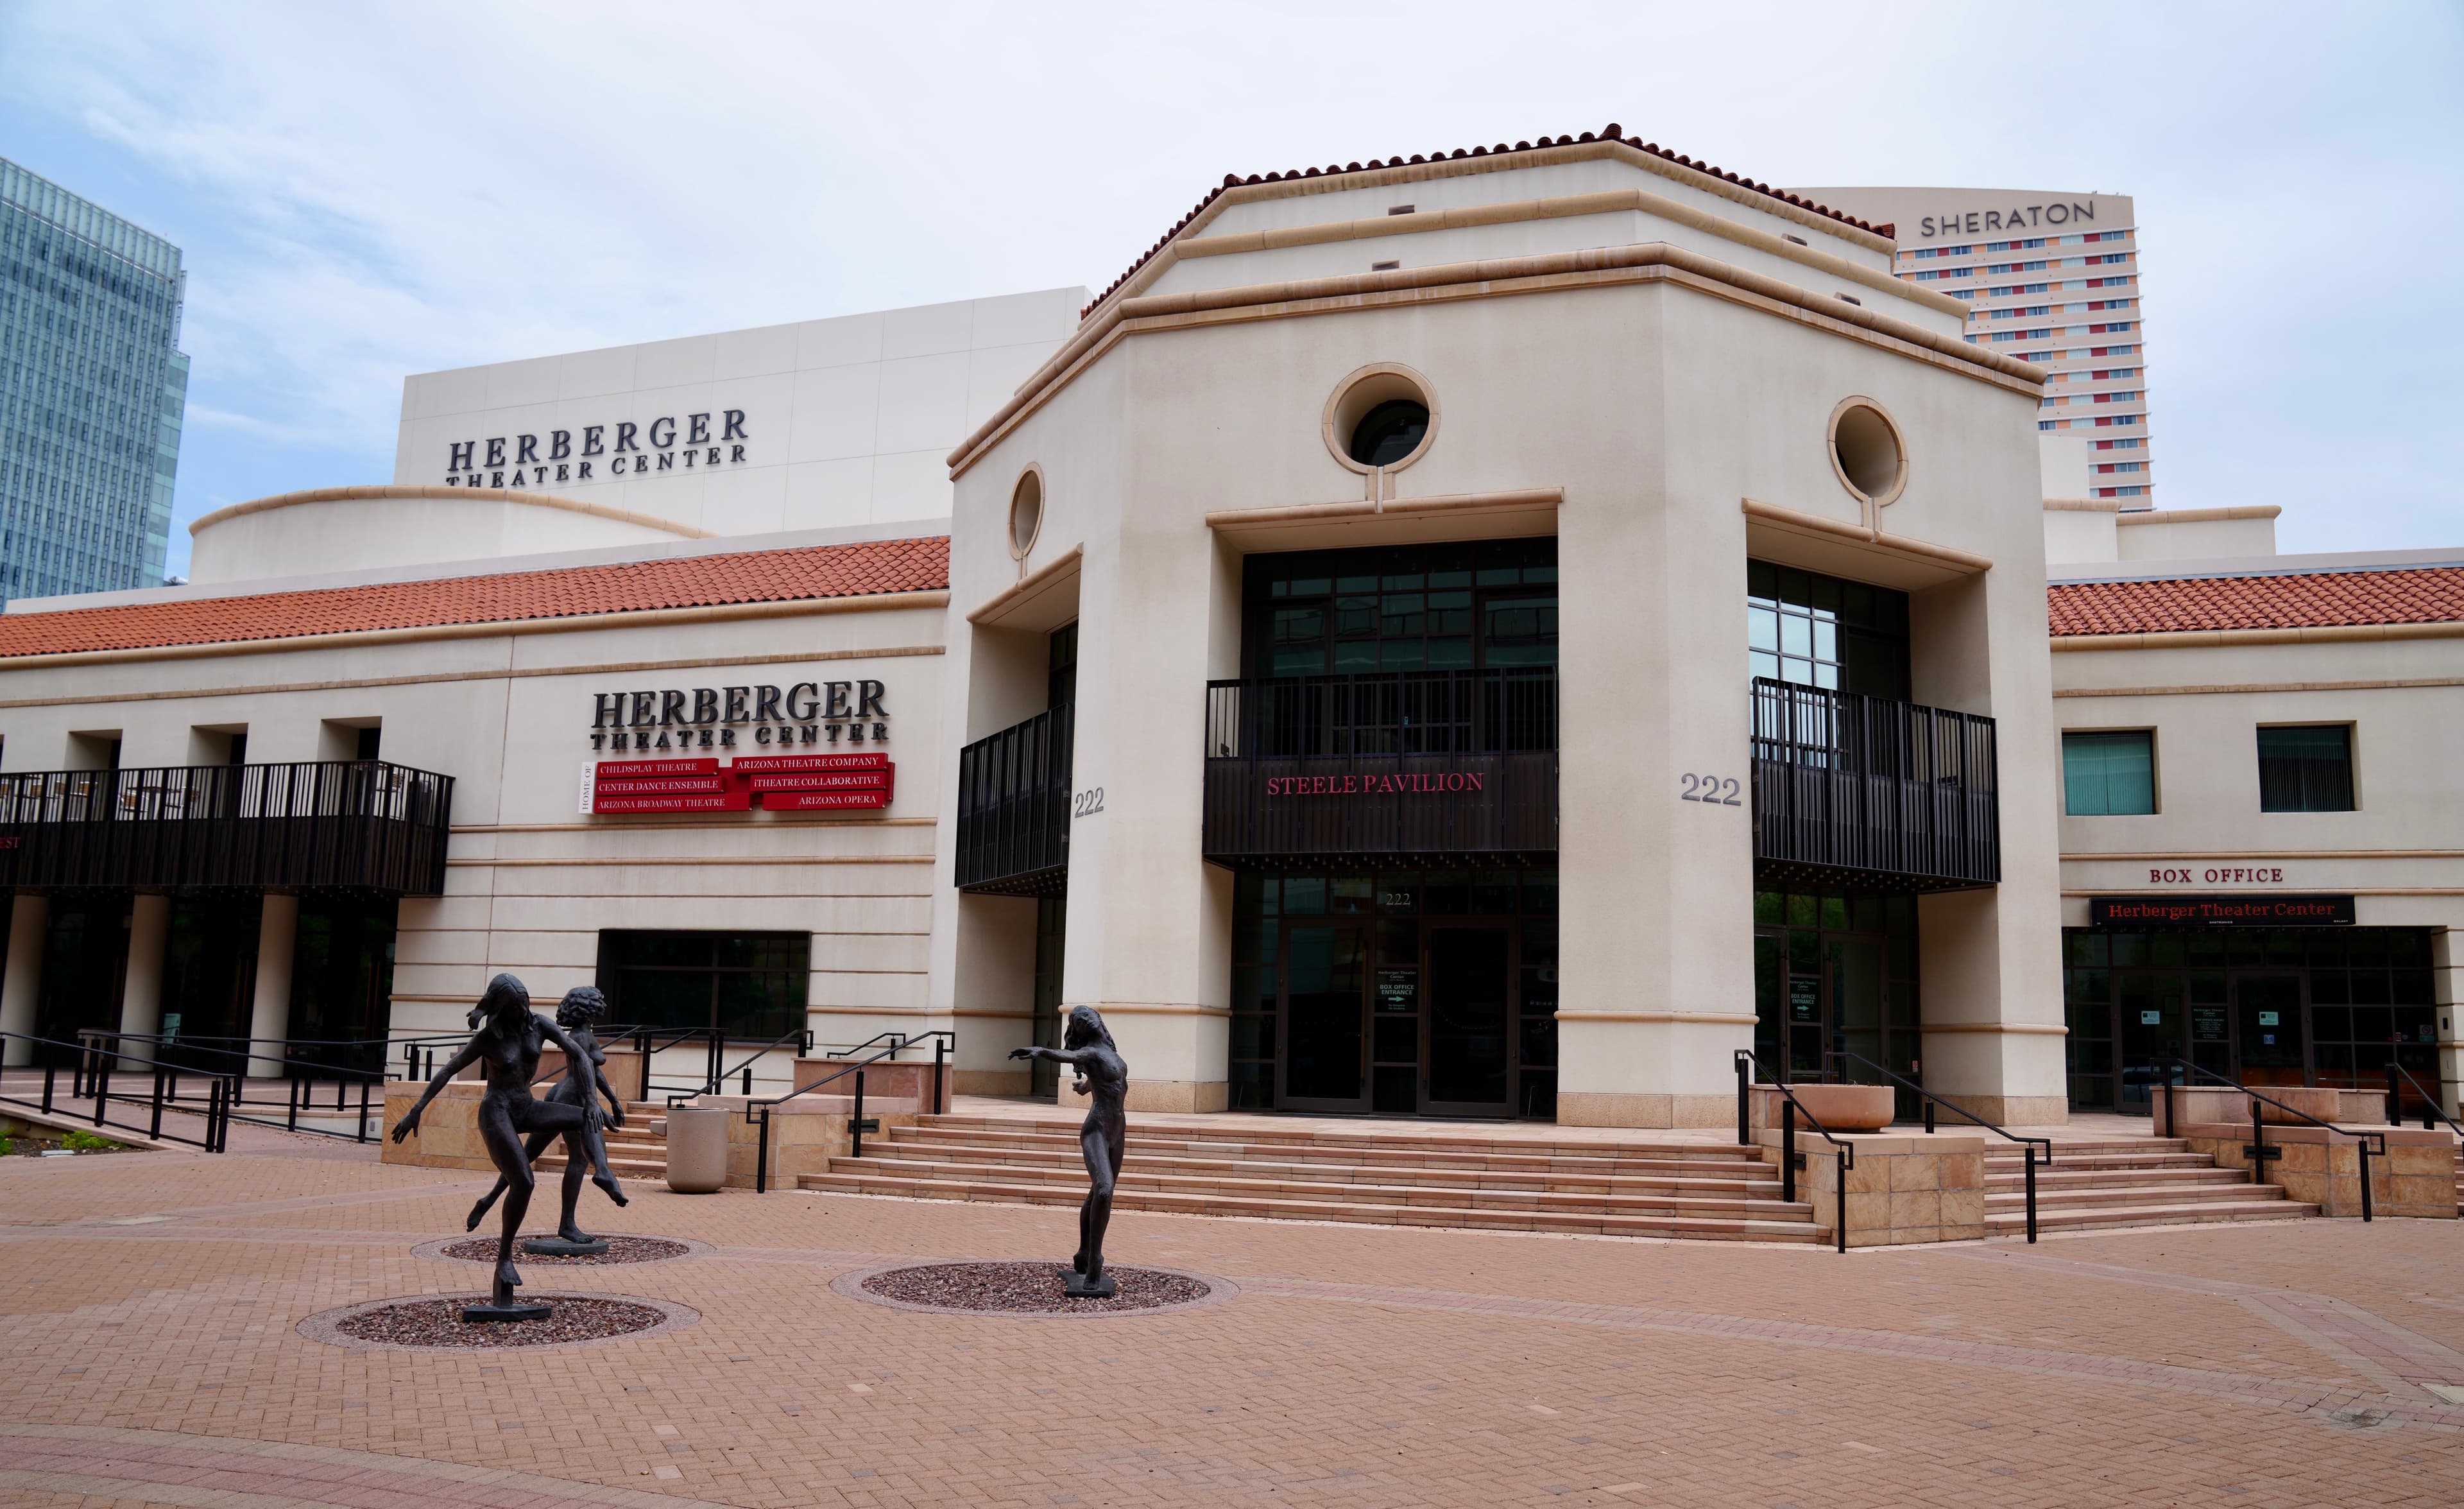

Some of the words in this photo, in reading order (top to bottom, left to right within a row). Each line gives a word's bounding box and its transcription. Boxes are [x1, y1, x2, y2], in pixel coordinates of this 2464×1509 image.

[1921, 200, 2094, 237] SHERATON
[447, 410, 749, 471] HERBERGER
[446, 461, 593, 488] THEATER
[612, 445, 746, 474] CENTER
[591, 680, 890, 729] HERBERGER
[590, 729, 737, 750] THEATER
[755, 722, 889, 745] CENTER
[585, 765, 592, 778] OF
[600, 764, 653, 774] CHILDSPLAY
[656, 763, 697, 772] THEATRE
[737, 760, 780, 769] ARIZONA
[782, 759, 827, 768] THEATRE
[829, 757, 878, 766] COMPANY
[599, 782, 635, 791] CENTER
[637, 782, 667, 791] DANCE
[669, 780, 718, 789] ENSEMBLE
[754, 777, 800, 787] iTHEATRE
[801, 776, 879, 786] COLLABORATIVE
[1267, 775, 1357, 795] STEELE
[1363, 773, 1484, 793] PAVILION
[1681, 772, 1741, 806] 222
[582, 780, 591, 810] HOME
[598, 800, 635, 809] ARIZONA
[637, 800, 683, 808] BROADWAY
[685, 798, 725, 807] THEATRE
[799, 796, 841, 805] ARIZONA
[844, 795, 877, 804] OPERA
[1074, 787, 1104, 818] 222
[2150, 869, 2192, 883] BOX
[2205, 868, 2283, 883] OFFICE
[1385, 893, 1411, 906] 222
[2109, 904, 2196, 920] Herberger
[2200, 902, 2270, 917] Theater
[2274, 902, 2336, 916] Center
